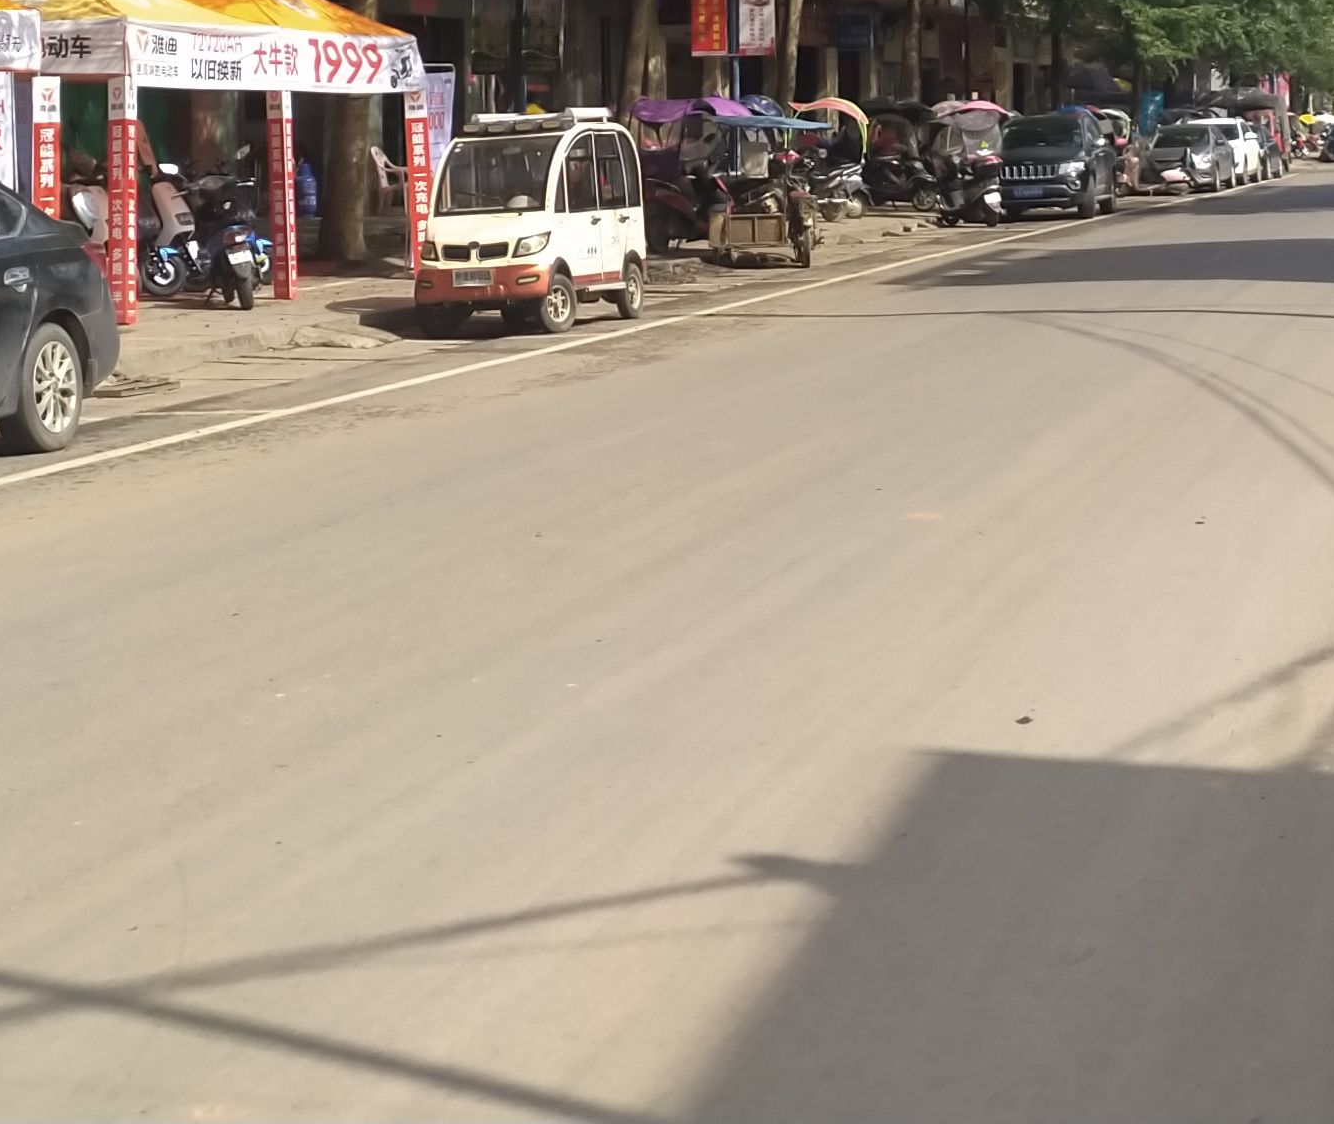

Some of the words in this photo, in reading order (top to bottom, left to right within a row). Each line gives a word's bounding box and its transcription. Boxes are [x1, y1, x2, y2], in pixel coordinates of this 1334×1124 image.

[41, 33, 92, 59] 动车
[151, 34, 178, 56] 雅迪
[191, 57, 242, 82] 以旧换新
[253, 43, 299, 77] 大牛款
[414, 172, 429, 214] 一次充电
